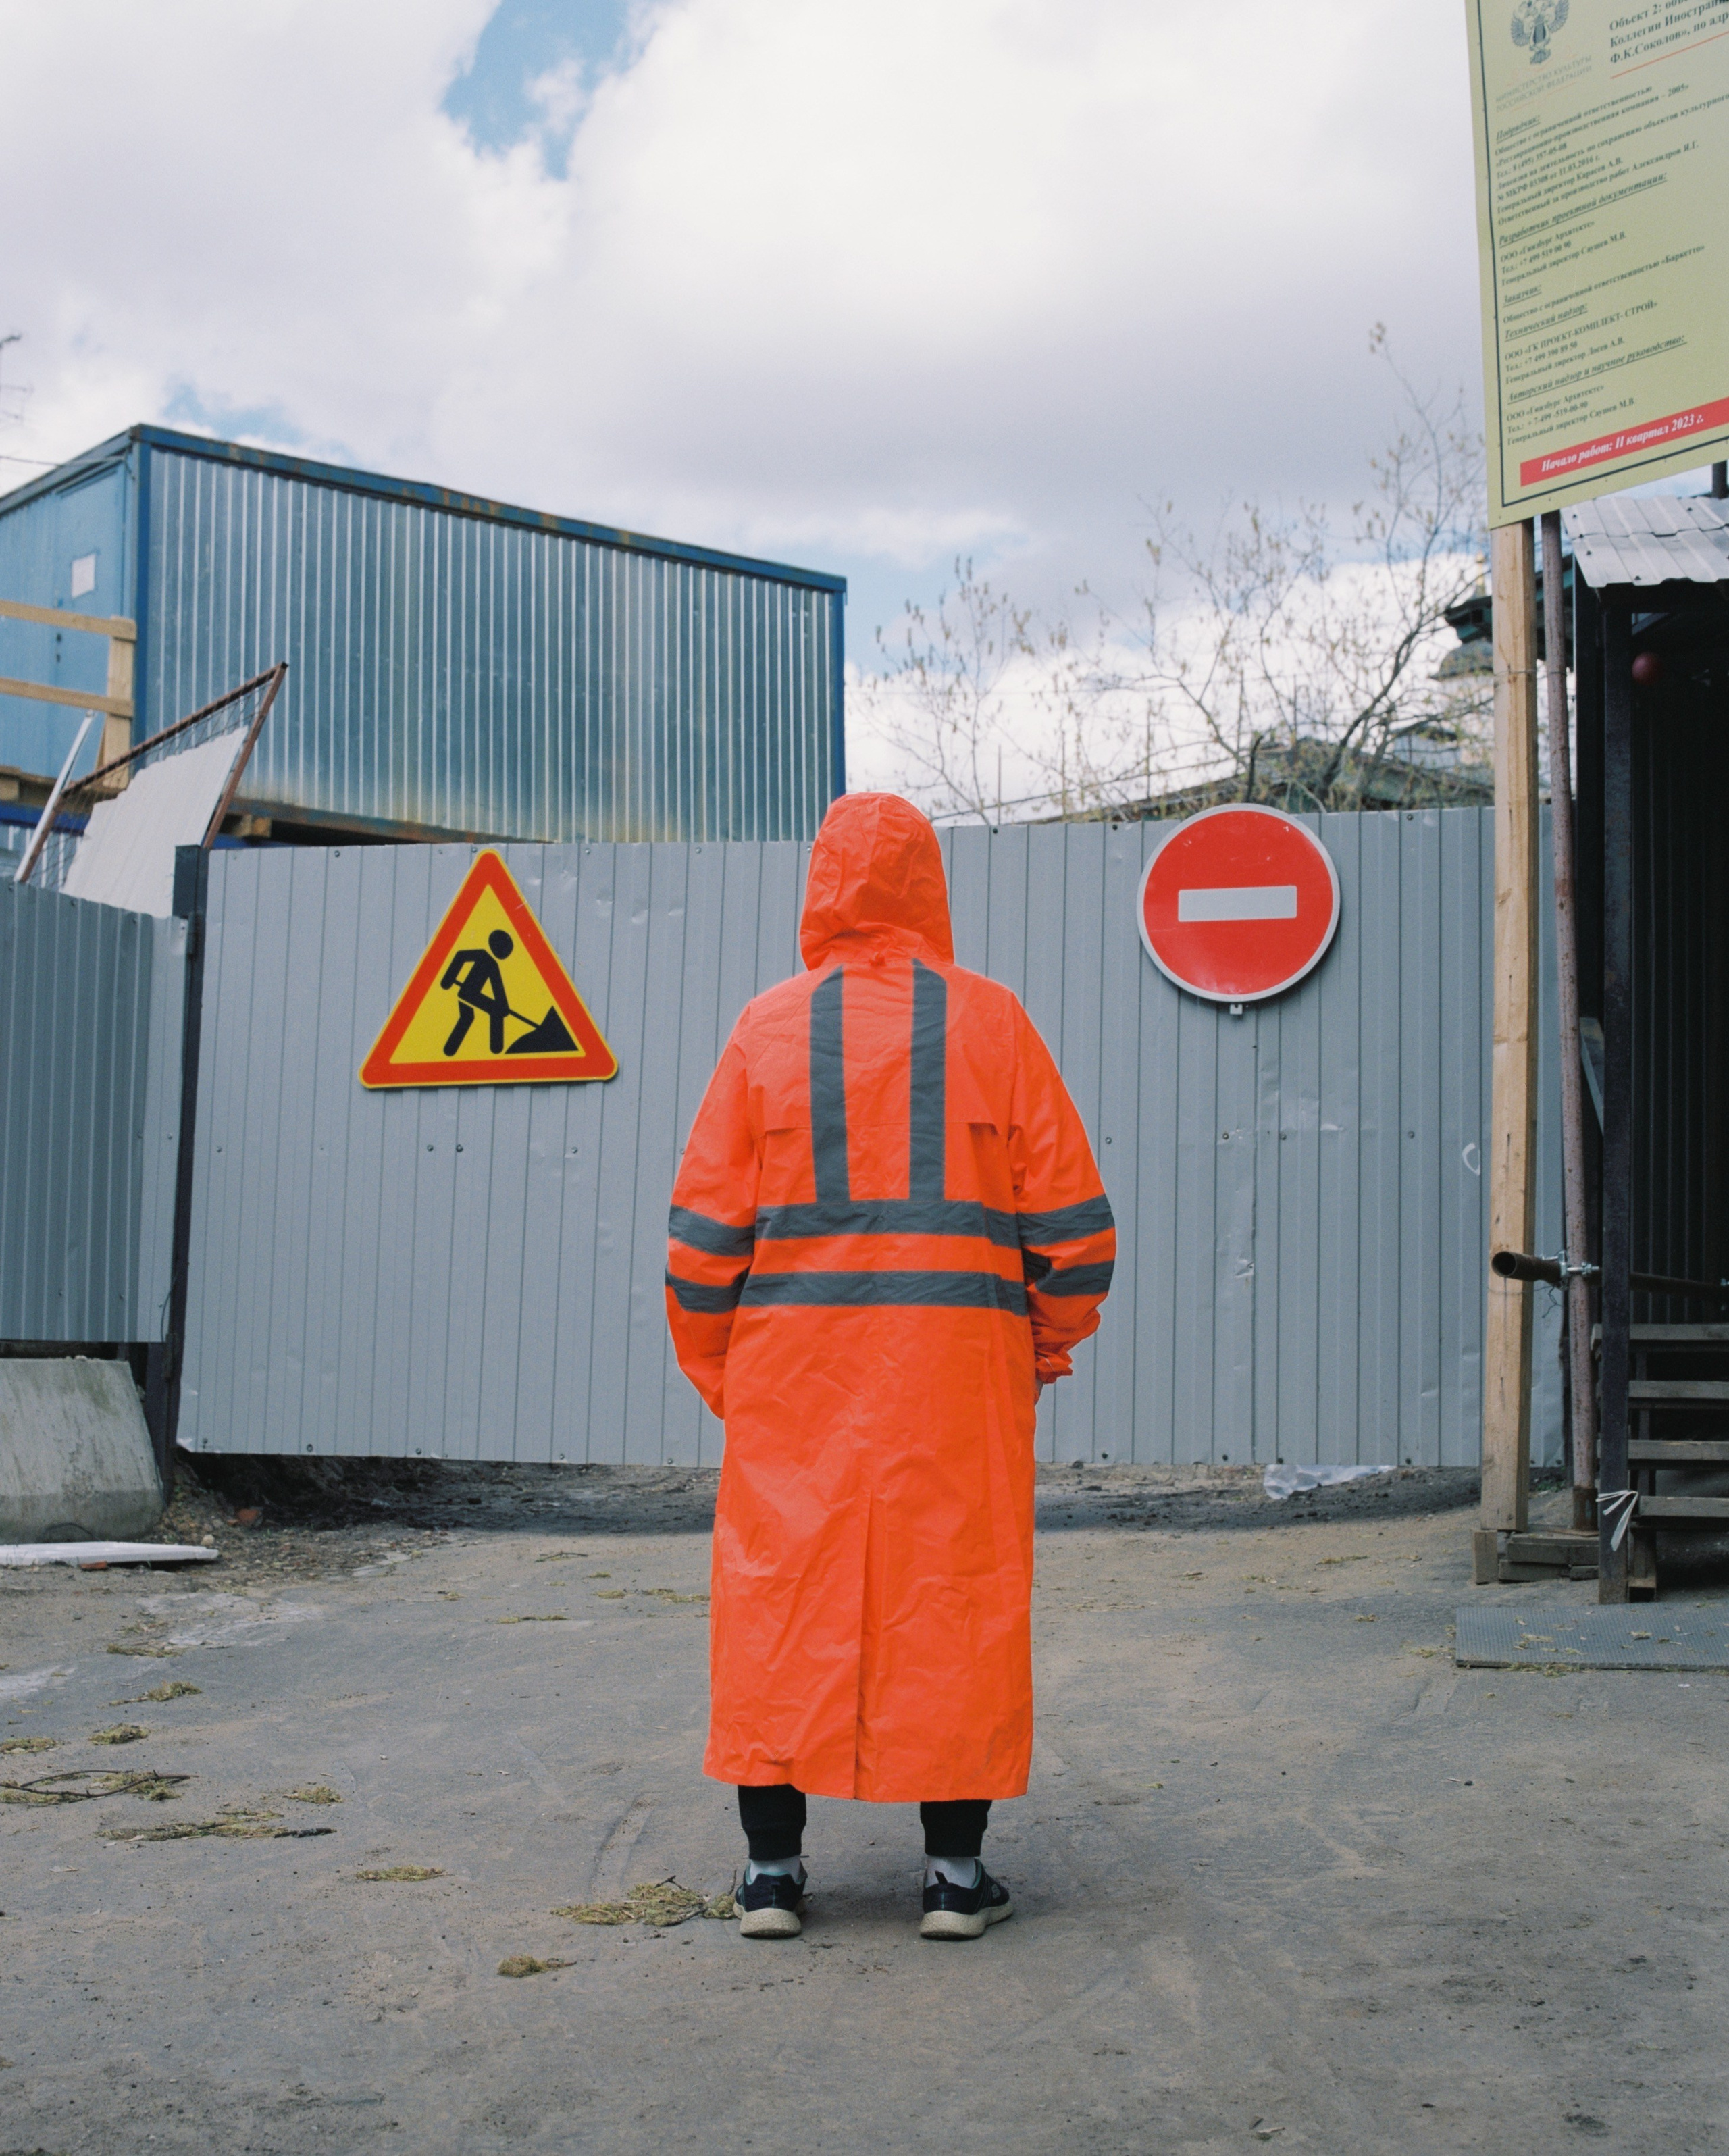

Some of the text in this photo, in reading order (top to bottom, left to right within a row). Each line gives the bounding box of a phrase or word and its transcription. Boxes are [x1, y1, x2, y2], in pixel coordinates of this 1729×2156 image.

[1609, 10, 1648, 31] Объект
[1653, 3, 1662, 16] 2:
[1693, 22, 1707, 32] по
[1610, 22, 1661, 49] Коллегии
[1553, 55, 1592, 76] КУЛЬТУРЫ
[1495, 138, 1527, 157] Общество
[1533, 113, 1582, 138] ограниченной
[1583, 86, 1653, 118] ответственностью
[1621, 96, 1659, 114] компания
[1539, 149, 1585, 172] деятельность
[1586, 145, 1596, 153] по
[1597, 127, 1643, 149] сохранению
[1643, 113, 1679, 130] объектов
[1497, 190, 1542, 214] Генеральный
[1544, 177, 1576, 195] директор
[1498, 199, 1551, 226] Ответственный
[1560, 176, 1608, 201] производство
[1609, 168, 1630, 182] работ
[1632, 149, 1682, 171] Александров
[1499, 173, 1667, 245] Разработчик проектной документации:
[1500, 250, 1518, 263] ООО
[1502, 263, 1547, 286] Генеральный
[1549, 251, 1580, 268] директор
[1503, 307, 1539, 324] Общество
[1544, 285, 1593, 309] ограниченной
[1594, 261, 1660, 290] ответственностью
[1505, 284, 1542, 304] Заказчик:
[1505, 303, 1587, 340] Технический надзор:
[1505, 349, 1523, 361] ООО
[1506, 363, 1553, 385] Генеральный
[1554, 352, 1586, 368] директор
[1509, 381, 1553, 401] Авторский
[1554, 371, 1582, 388] надзор
[1591, 355, 1626, 376] научное
[1627, 336, 1684, 362] руководство:
[1506, 410, 1525, 421] ООО
[1507, 425, 1554, 446] Генеральный
[1556, 414, 1589, 430] директор
[1541, 454, 1578, 473] Начало
[1578, 442, 1614, 464] работ:
[1615, 436, 1625, 449] II
[1626, 425, 1669, 446] квартал
[1671, 413, 1695, 432] 2023
